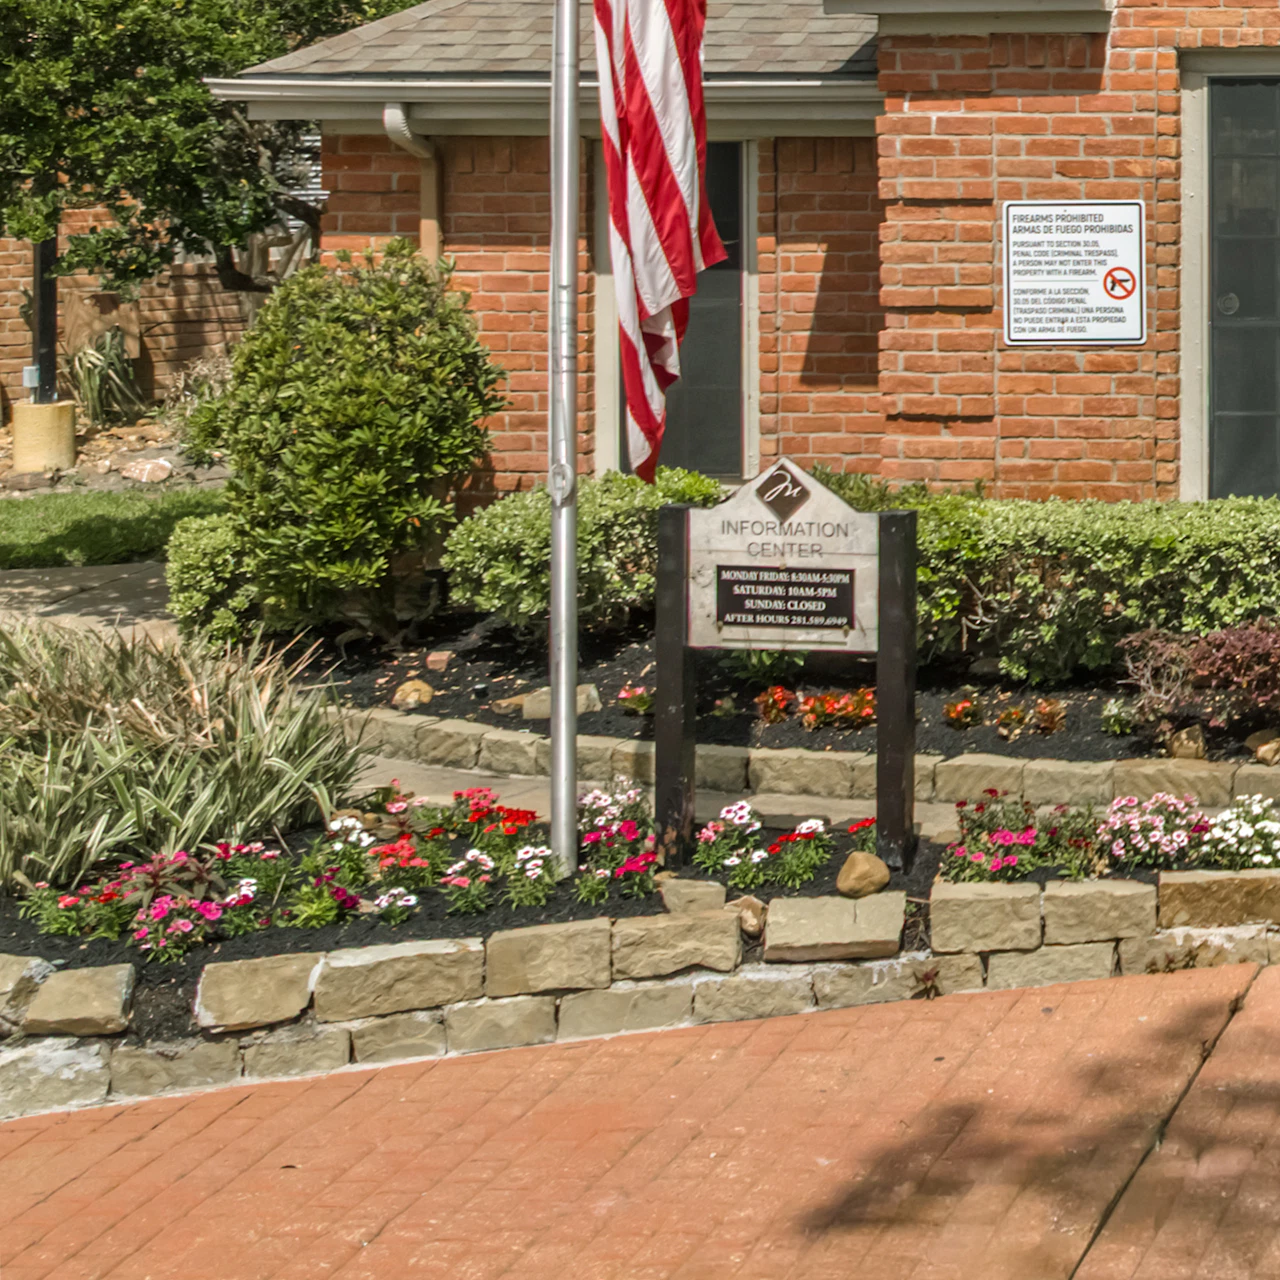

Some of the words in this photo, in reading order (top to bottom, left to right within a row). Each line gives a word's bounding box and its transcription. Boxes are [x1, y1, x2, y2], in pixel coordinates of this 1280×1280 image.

[1012, 214, 1053, 223] FIREARMS
[1055, 214, 1104, 223] PROHIBITED
[1012, 225, 1041, 233] ARMAS
[1043, 225, 1053, 233] DE
[1055, 225, 1082, 233] FUEGO
[1084, 225, 1133, 233] PROHIBIDAS
[721, 520, 849, 537] INFORMATION
[747, 542, 824, 558] CENTER
[721, 570, 758, 581] MONDAY
[758, 571, 790, 582] FRIDAY:
[733, 584, 786, 595] SATURDAY:
[788, 586, 837, 598] 10AM-5PM
[744, 599, 786, 609] SUNDAY:
[787, 601, 826, 611] CLOSED
[724, 614, 755, 623] AFTER
[756, 614, 790, 624] HOURS
